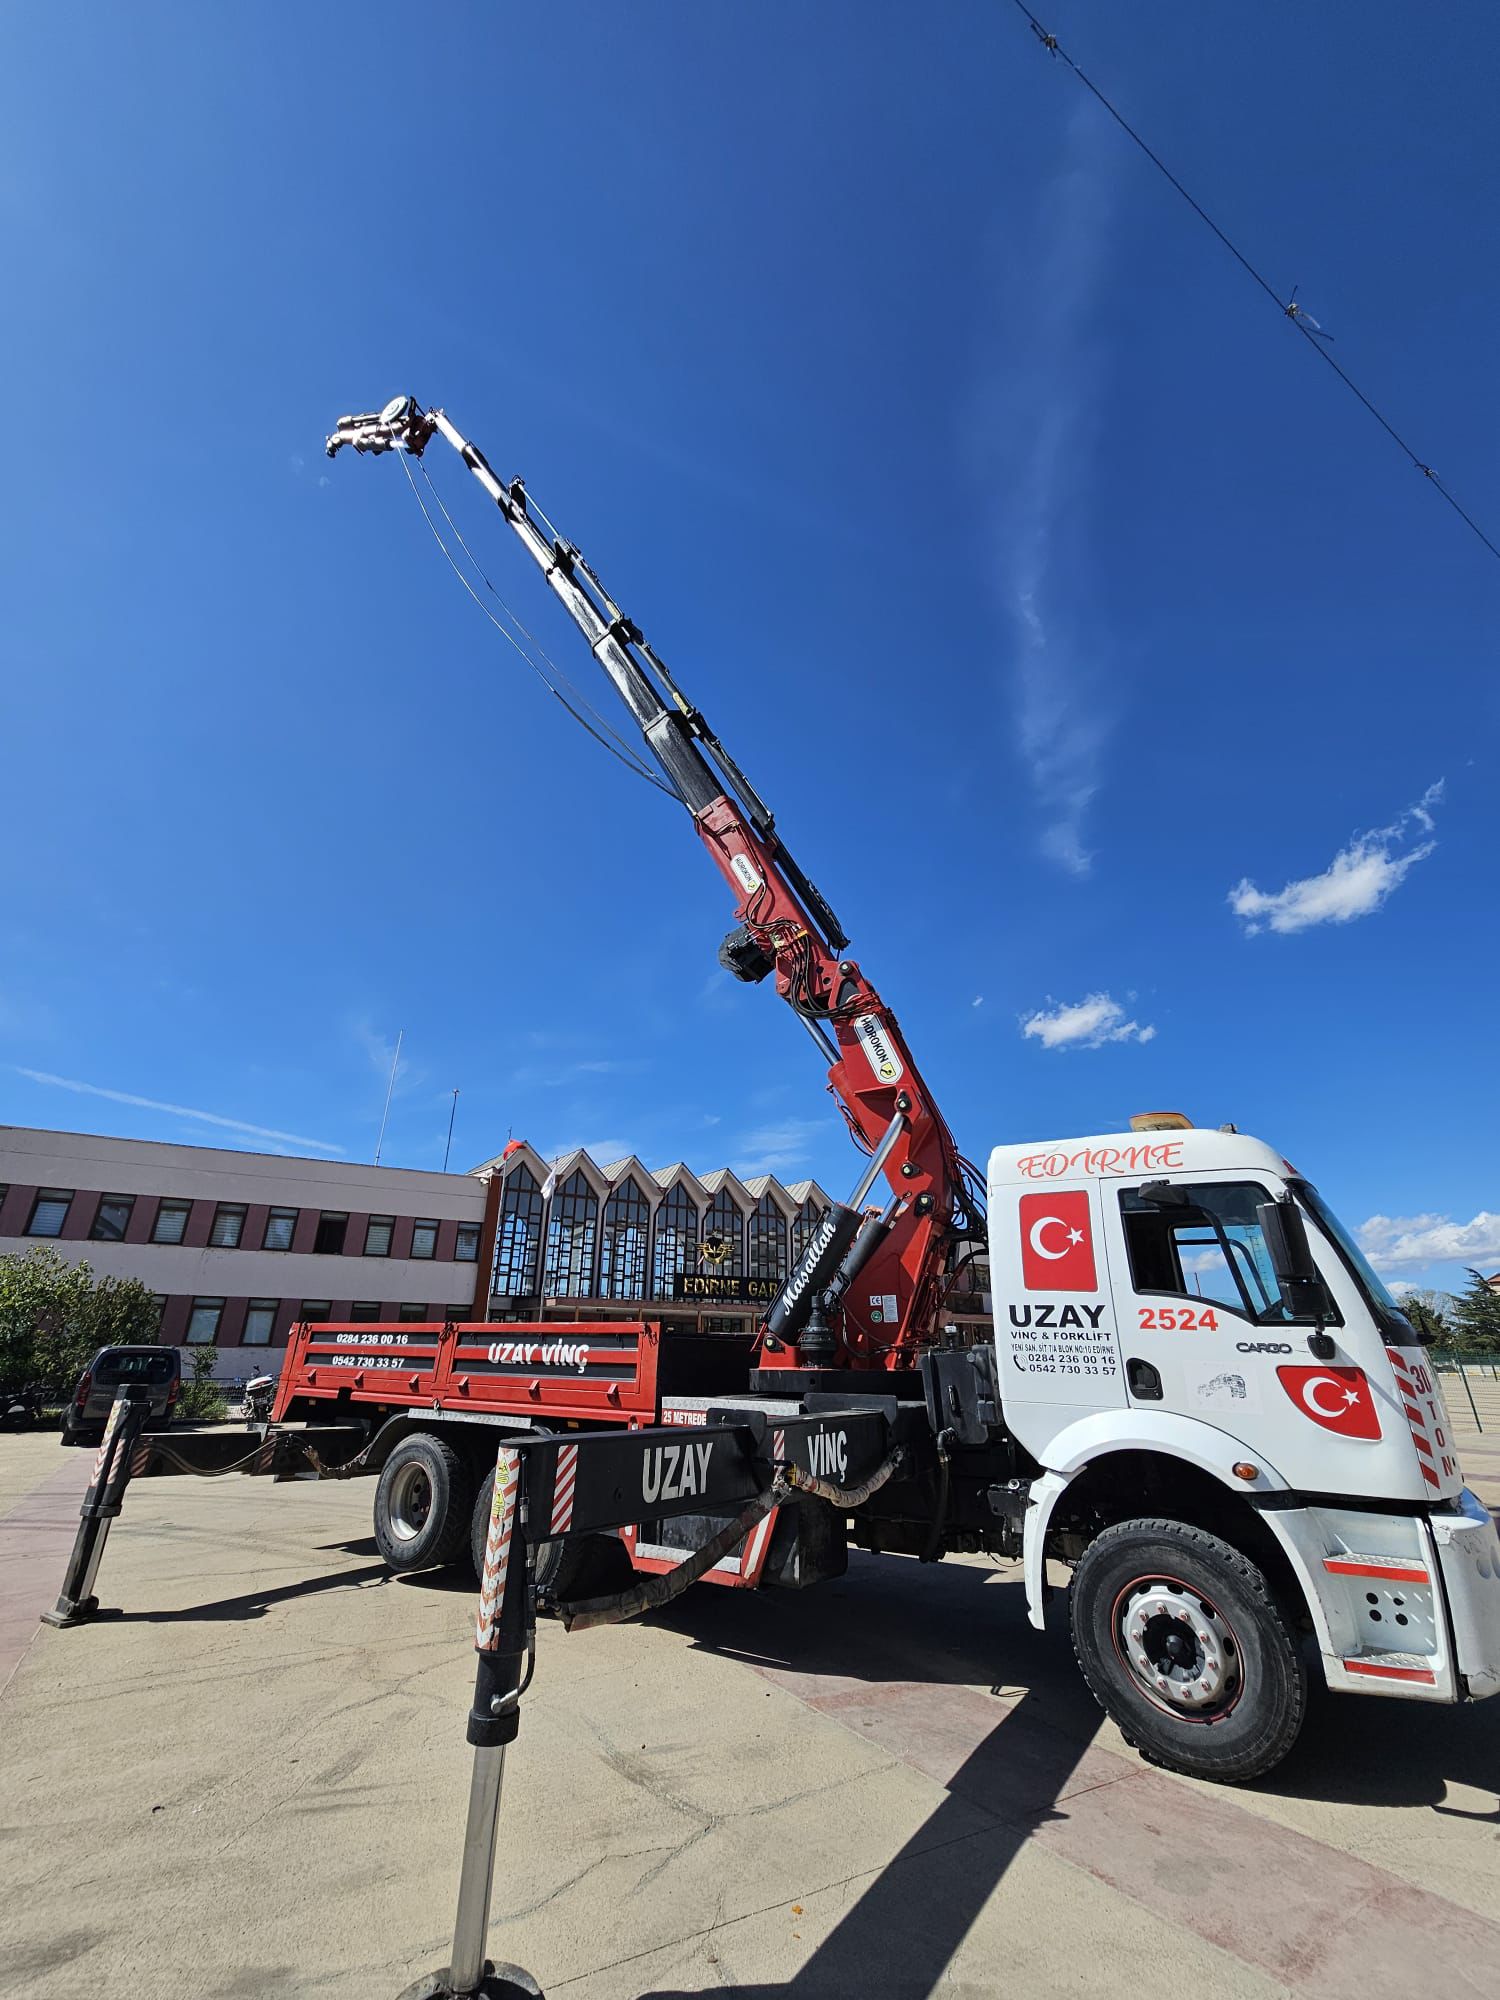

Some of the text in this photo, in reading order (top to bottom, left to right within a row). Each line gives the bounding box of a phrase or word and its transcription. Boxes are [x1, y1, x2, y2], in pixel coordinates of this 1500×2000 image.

[1017, 1142, 1184, 1178] EDİRNE
[782, 1221, 836, 1316] Maşallah
[1008, 1304, 1106, 1328] UZAY
[1138, 1308, 1219, 1331] 2524
[337, 1333, 409, 1344] 0284 236 00 16
[1010, 1330, 1112, 1341] VİNÇ & FORKLİFT
[487, 1338, 590, 1374] UZAY VİNÇ
[1236, 1342, 1293, 1354] CARGO
[332, 1355, 405, 1368] 0542 730 33 57
[1028, 1354, 1115, 1365] 0284 236 00 16
[1029, 1364, 1116, 1375] 0542 730 33 57
[1410, 1364, 1432, 1395] 30
[663, 1411, 672, 1423] 25
[642, 1423, 848, 1503] UZAY VİNÇ
